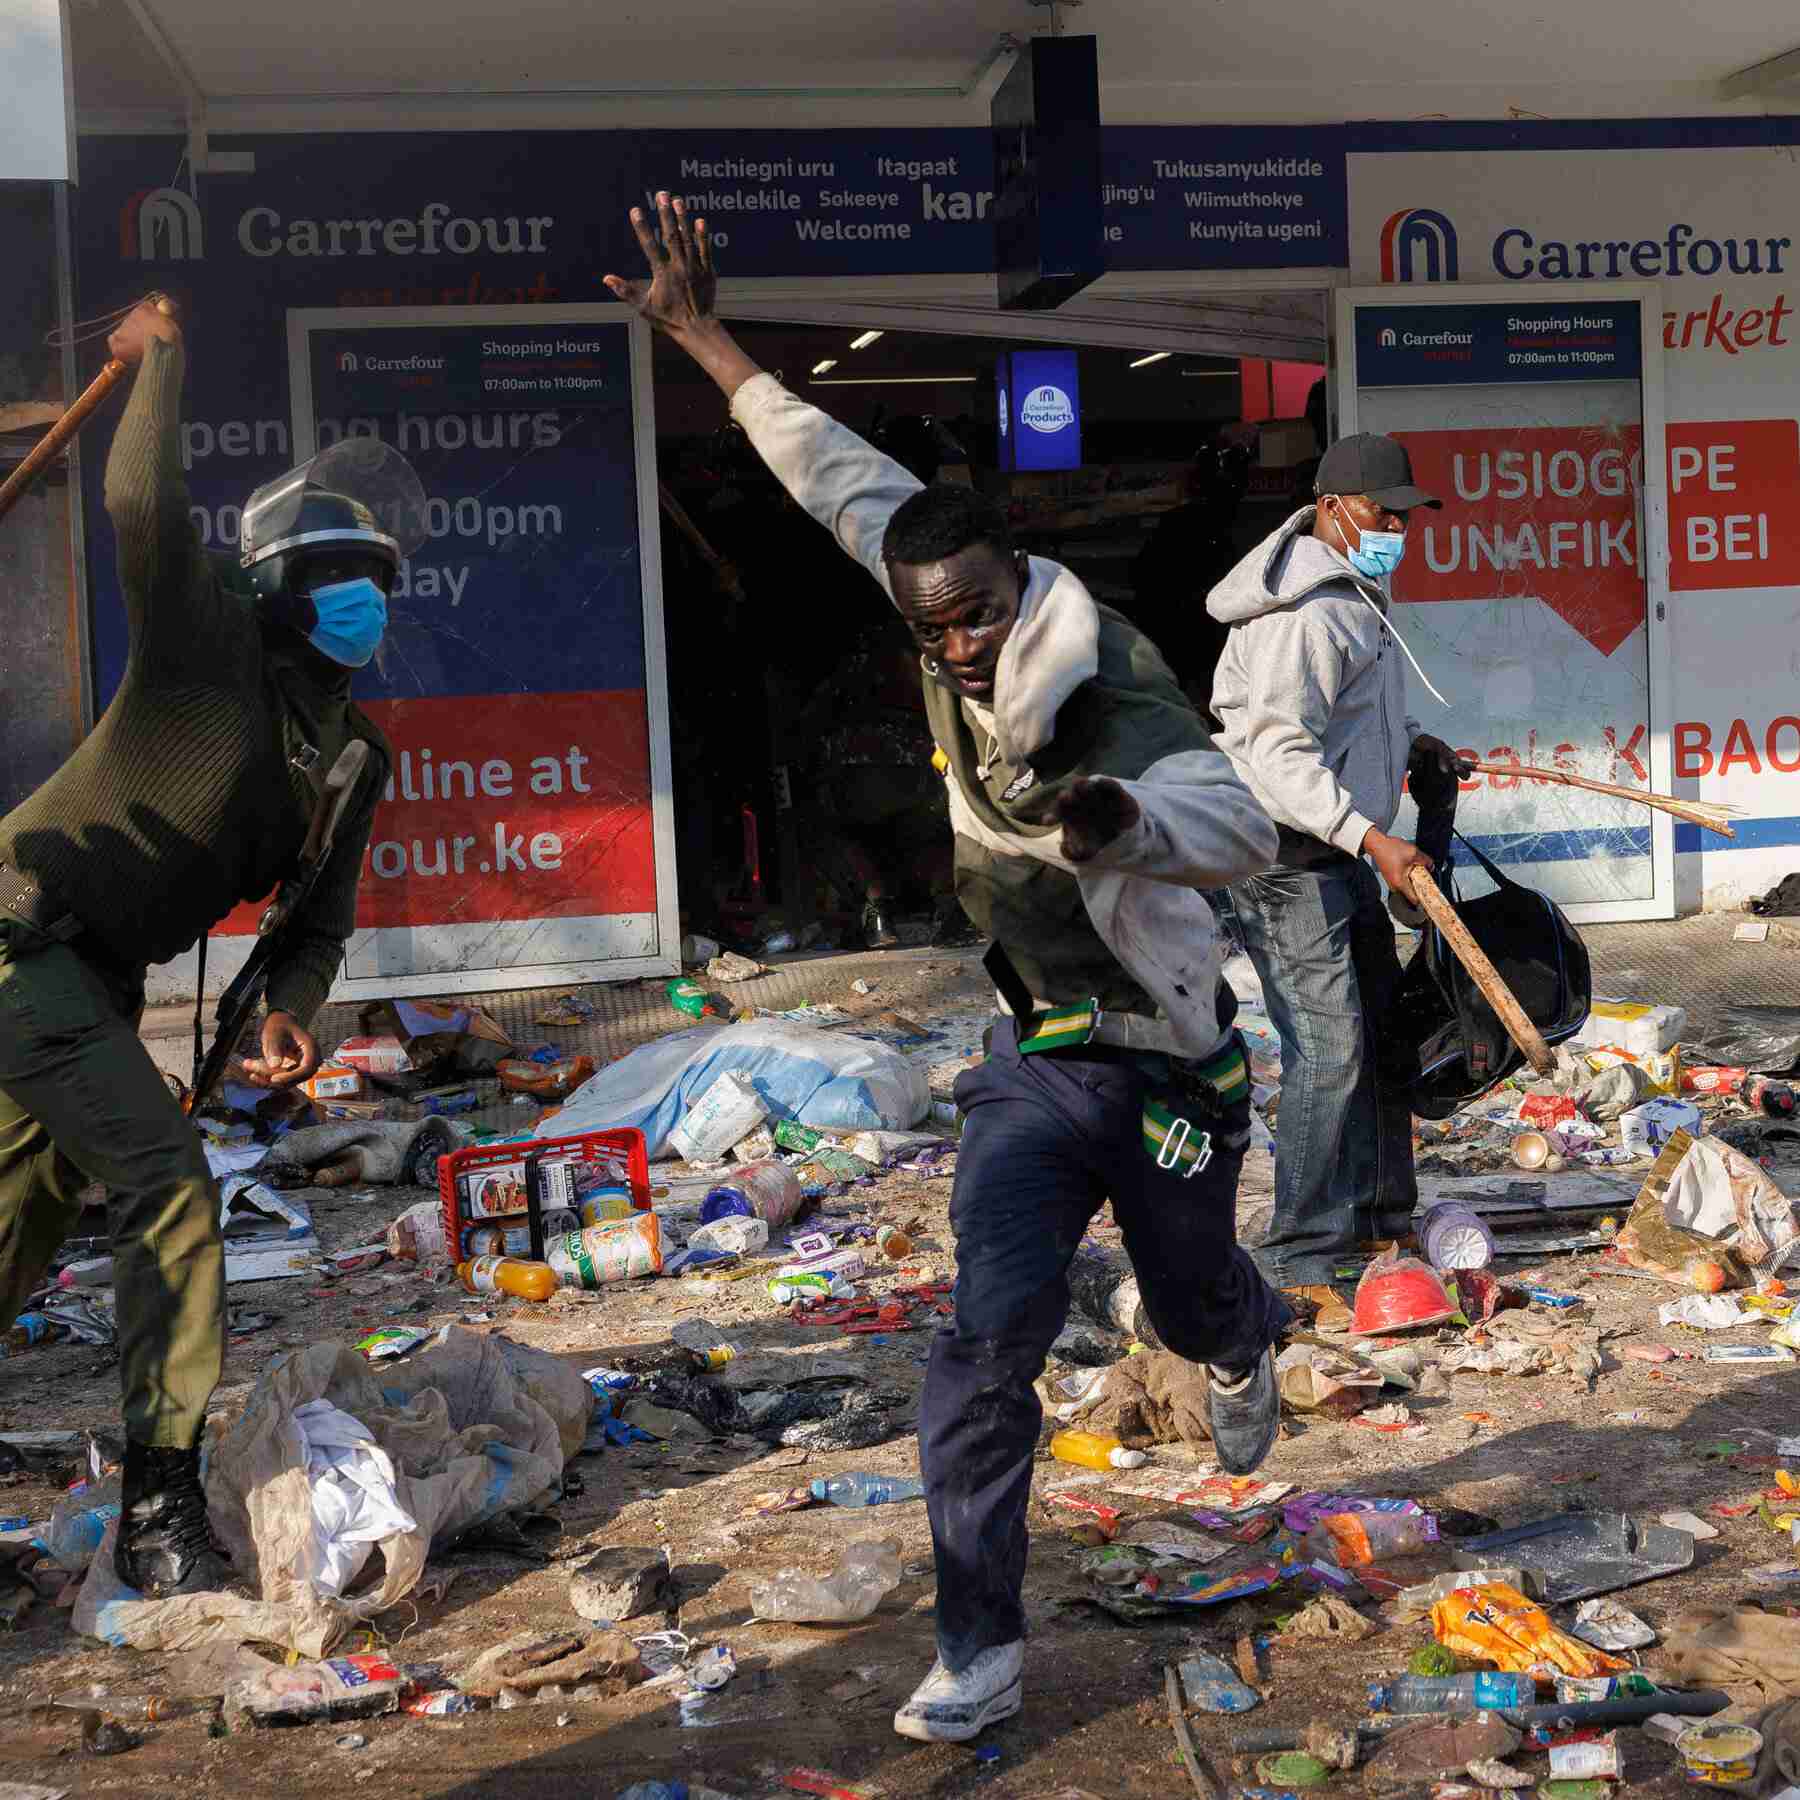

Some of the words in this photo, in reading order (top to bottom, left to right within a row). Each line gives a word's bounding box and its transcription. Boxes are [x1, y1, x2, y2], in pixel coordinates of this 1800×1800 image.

[681, 158, 792, 181] Machiegni
[799, 164, 835, 178] uru
[878, 157, 957, 180] Itagaat
[1153, 158, 1323, 182] Tukusanyukidde
[818, 190, 900, 210] Sokeeye
[1183, 191, 1304, 210] Wiimuthokye
[237, 203, 555, 257] Carrefour
[795, 220, 912, 242] Welcome
[1189, 221, 1264, 242] Kunyita
[1268, 220, 1321, 242] ugeni
[1493, 224, 1793, 281] Carrefour
[1507, 317, 1571, 333] Shopping
[1573, 316, 1613, 330] Hours
[482, 341, 553, 358] Shopping
[556, 340, 601, 353] Hours
[1402, 331, 1473, 346] Carrefour
[365, 354, 445, 371] Carrefour
[1508, 352, 1556, 365] 07:00am
[1558, 352, 1568, 364] to
[1571, 351, 1615, 364] 11:00pm
[484, 378, 537, 391] 07:00am
[539, 378, 552, 390] to
[554, 378, 602, 391] 11:00pm
[399, 406, 562, 450] hours
[1024, 412, 1073, 422] Products
[1687, 513, 1769, 563] BEI
[384, 747, 512, 801] line
[530, 745, 592, 795] at
[364, 823, 563, 879] our.ke
